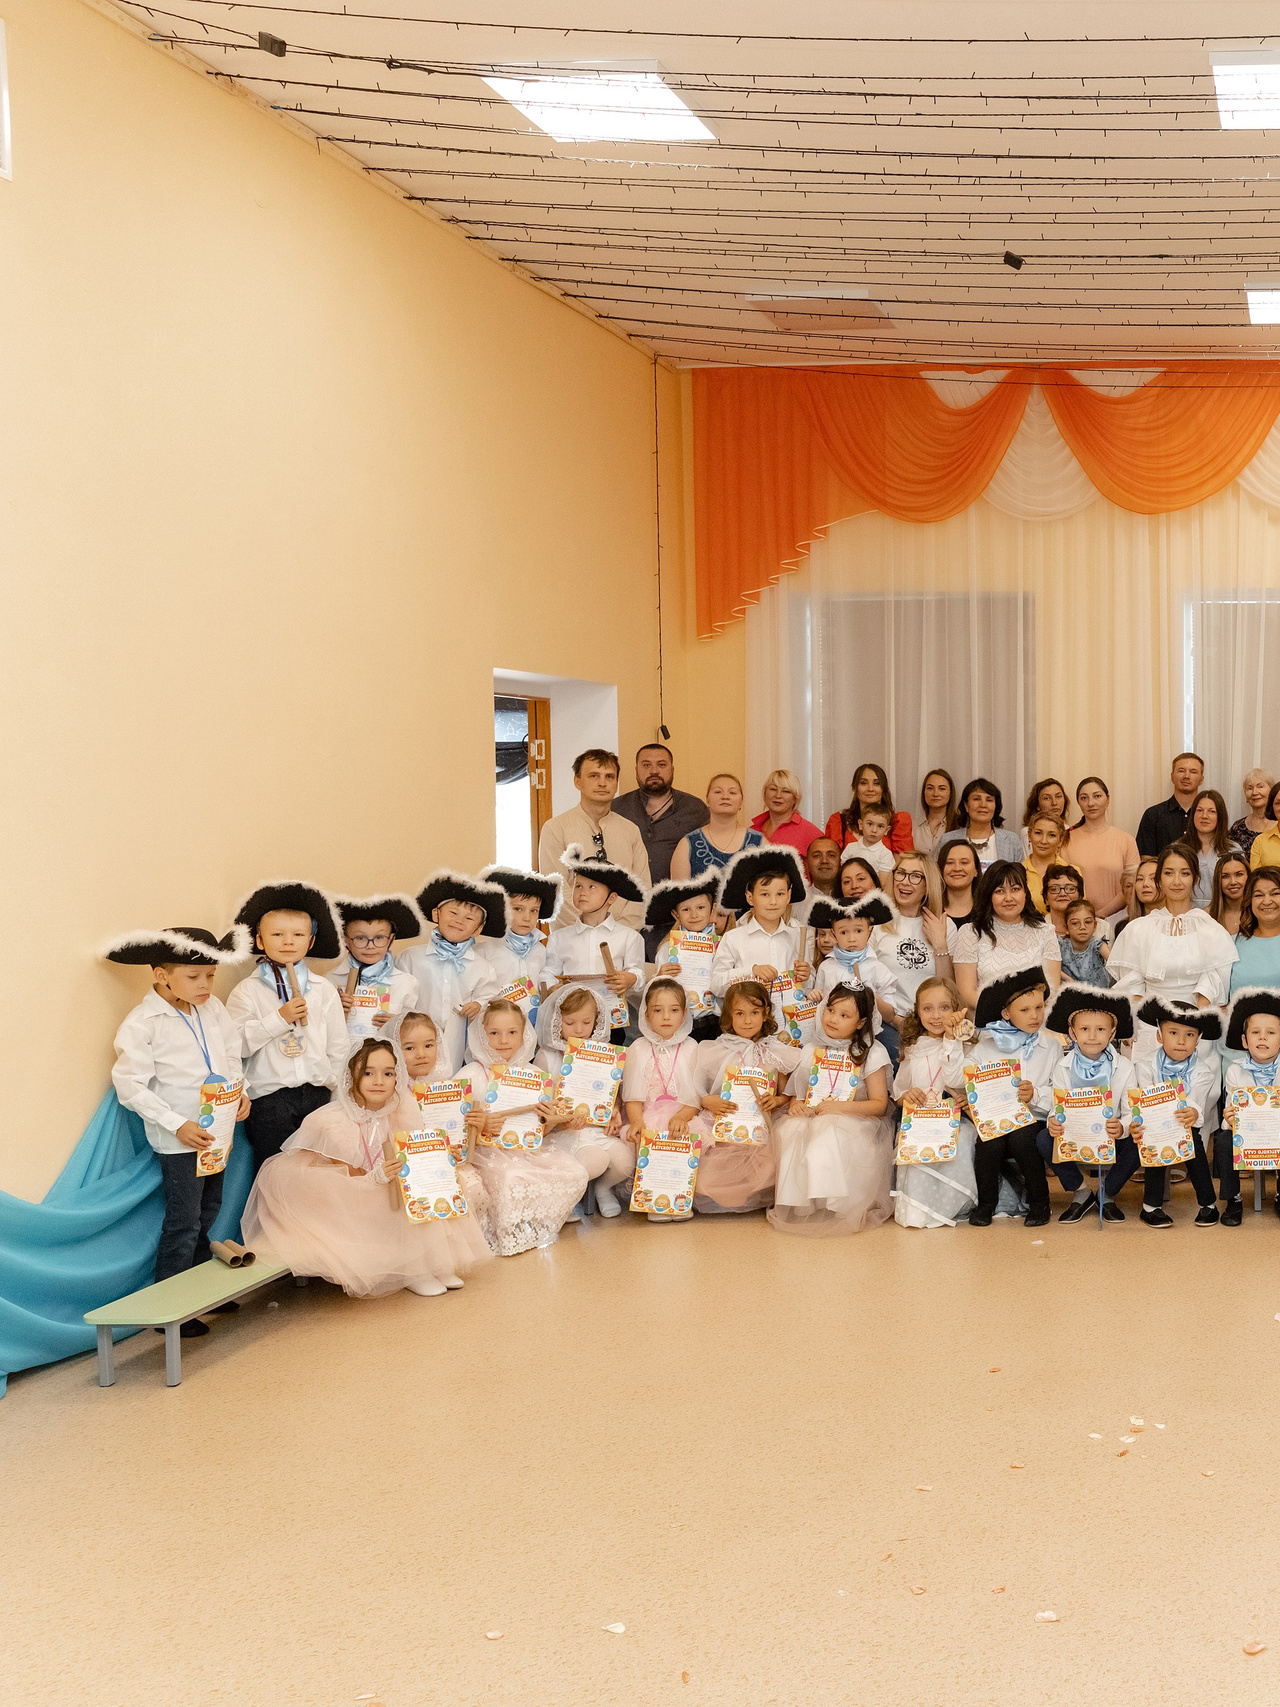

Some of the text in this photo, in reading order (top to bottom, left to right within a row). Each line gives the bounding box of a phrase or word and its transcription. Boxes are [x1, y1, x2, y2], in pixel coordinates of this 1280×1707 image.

[794, 1001, 819, 1012] ДИПЛО
[580, 1042, 614, 1053] ДИПЛОМ
[976, 1062, 1008, 1072] ДИПЛОМ
[504, 1070, 540, 1080] ДИПЛОМ
[736, 1069, 767, 1079] ДИПЛОМ
[426, 1083, 460, 1093] ДИПЛОМ
[1141, 1084, 1172, 1097] ДИПЛОМ
[1066, 1090, 1100, 1098] ДИПЛОМ
[408, 1133, 440, 1142] ДИПЛОМ
